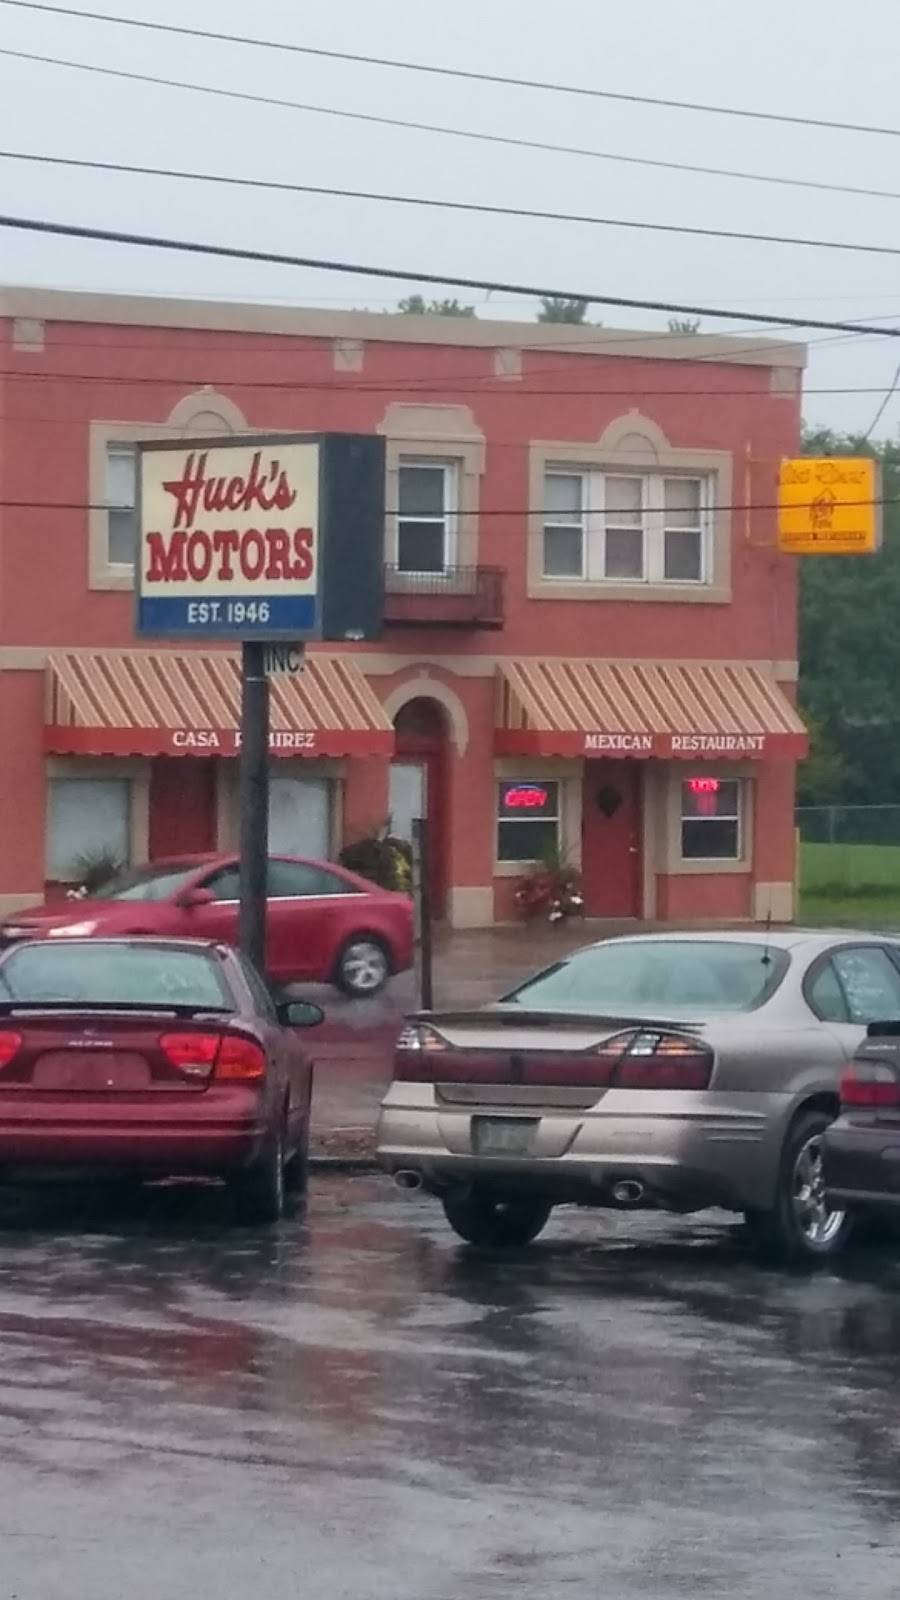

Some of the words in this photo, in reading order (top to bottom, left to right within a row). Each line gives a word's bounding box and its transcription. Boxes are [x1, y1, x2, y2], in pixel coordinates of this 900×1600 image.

[162, 451, 297, 528] Huck's
[146, 527, 314, 582] MOTORS
[187, 602, 223, 623] EST.
[227, 602, 271, 622] 1946
[265, 645, 305, 673] INC.
[172, 731, 220, 747] CASA
[584, 734, 653, 750] MEXICAN
[671, 735, 766, 751] RESTAURANT
